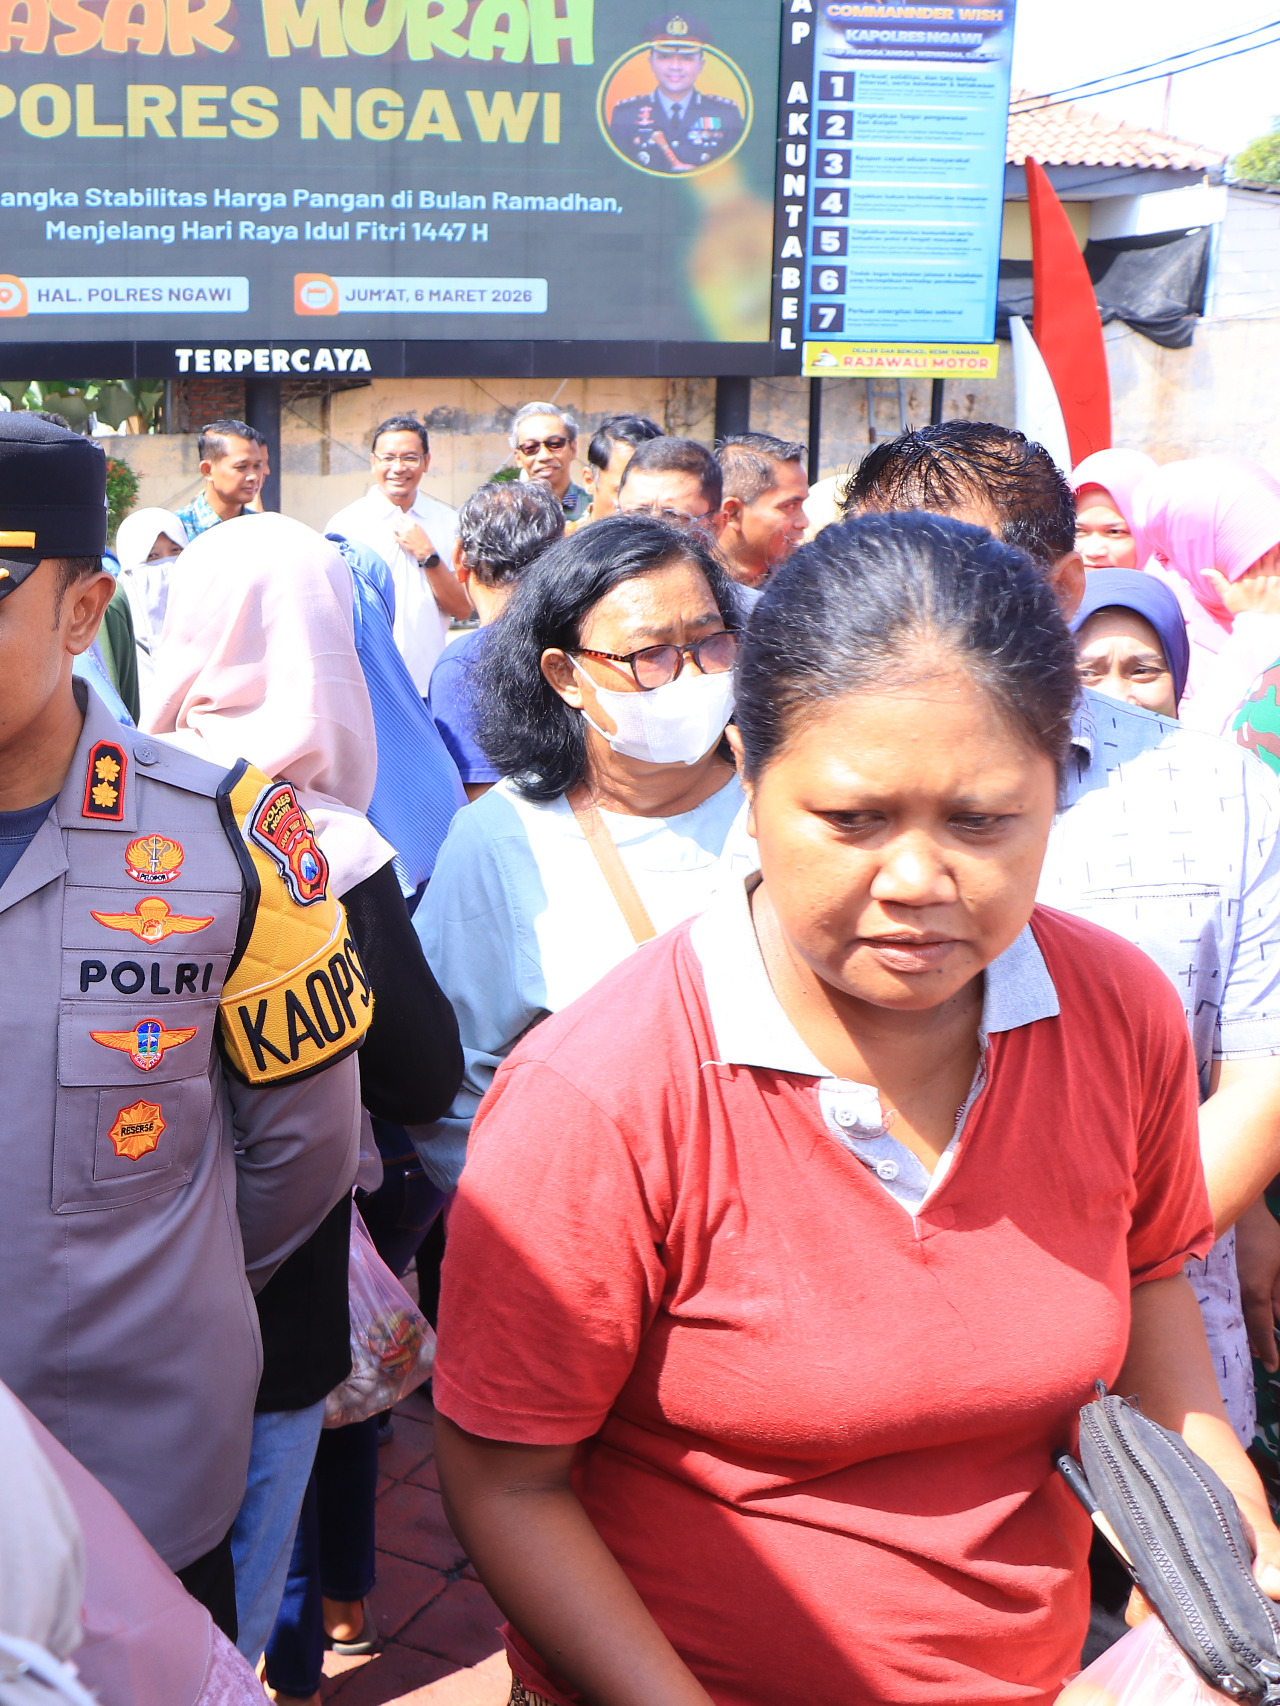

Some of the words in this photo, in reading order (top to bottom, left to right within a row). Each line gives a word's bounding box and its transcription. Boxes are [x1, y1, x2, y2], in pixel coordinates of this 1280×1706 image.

[960, 8, 1004, 21] WISH
[261, 0, 595, 65] MURAH
[845, 28, 926, 43] KAPOLRES
[927, 31, 984, 45] NGAWI
[830, 76, 845, 98] 1
[300, 87, 561, 144] NGAWI
[825, 115, 846, 137] 2
[823, 153, 844, 176] 3
[85, 187, 208, 209] Stabilitas
[214, 188, 286, 212] Harga
[293, 188, 385, 212] Pangan
[391, 189, 413, 209] di
[419, 190, 487, 210] Bulan
[492, 191, 624, 214] Ramadhan,
[820, 192, 843, 214] 4
[780, 81, 810, 351] AKUNTABEL
[46, 220, 176, 245] Menjelang
[182, 220, 232, 240] Hari
[238, 221, 299, 245] Raya
[305, 221, 350, 241] Idul
[355, 221, 406, 241] Fitri
[411, 222, 467, 242] 1447
[472, 222, 489, 242] H
[820, 230, 841, 253] 5
[818, 269, 839, 293] 6
[37, 288, 82, 303] HAL.
[88, 288, 163, 303] POLRES
[168, 287, 232, 302] NGAWI
[414, 288, 424, 303] 6
[429, 289, 487, 303] MARET
[491, 289, 533, 303] 2026
[818, 307, 837, 329] 7
[175, 347, 372, 373] TERPERCAYA
[843, 356, 926, 368] RAJAWALI
[933, 358, 989, 369] MOTOR
[261, 793, 292, 833] POLRES
[270, 804, 292, 831] NGAWI
[80, 959, 213, 996] POLRI
[238, 922, 371, 1072] KAOPS
[121, 1122, 154, 1137] RESERSE
